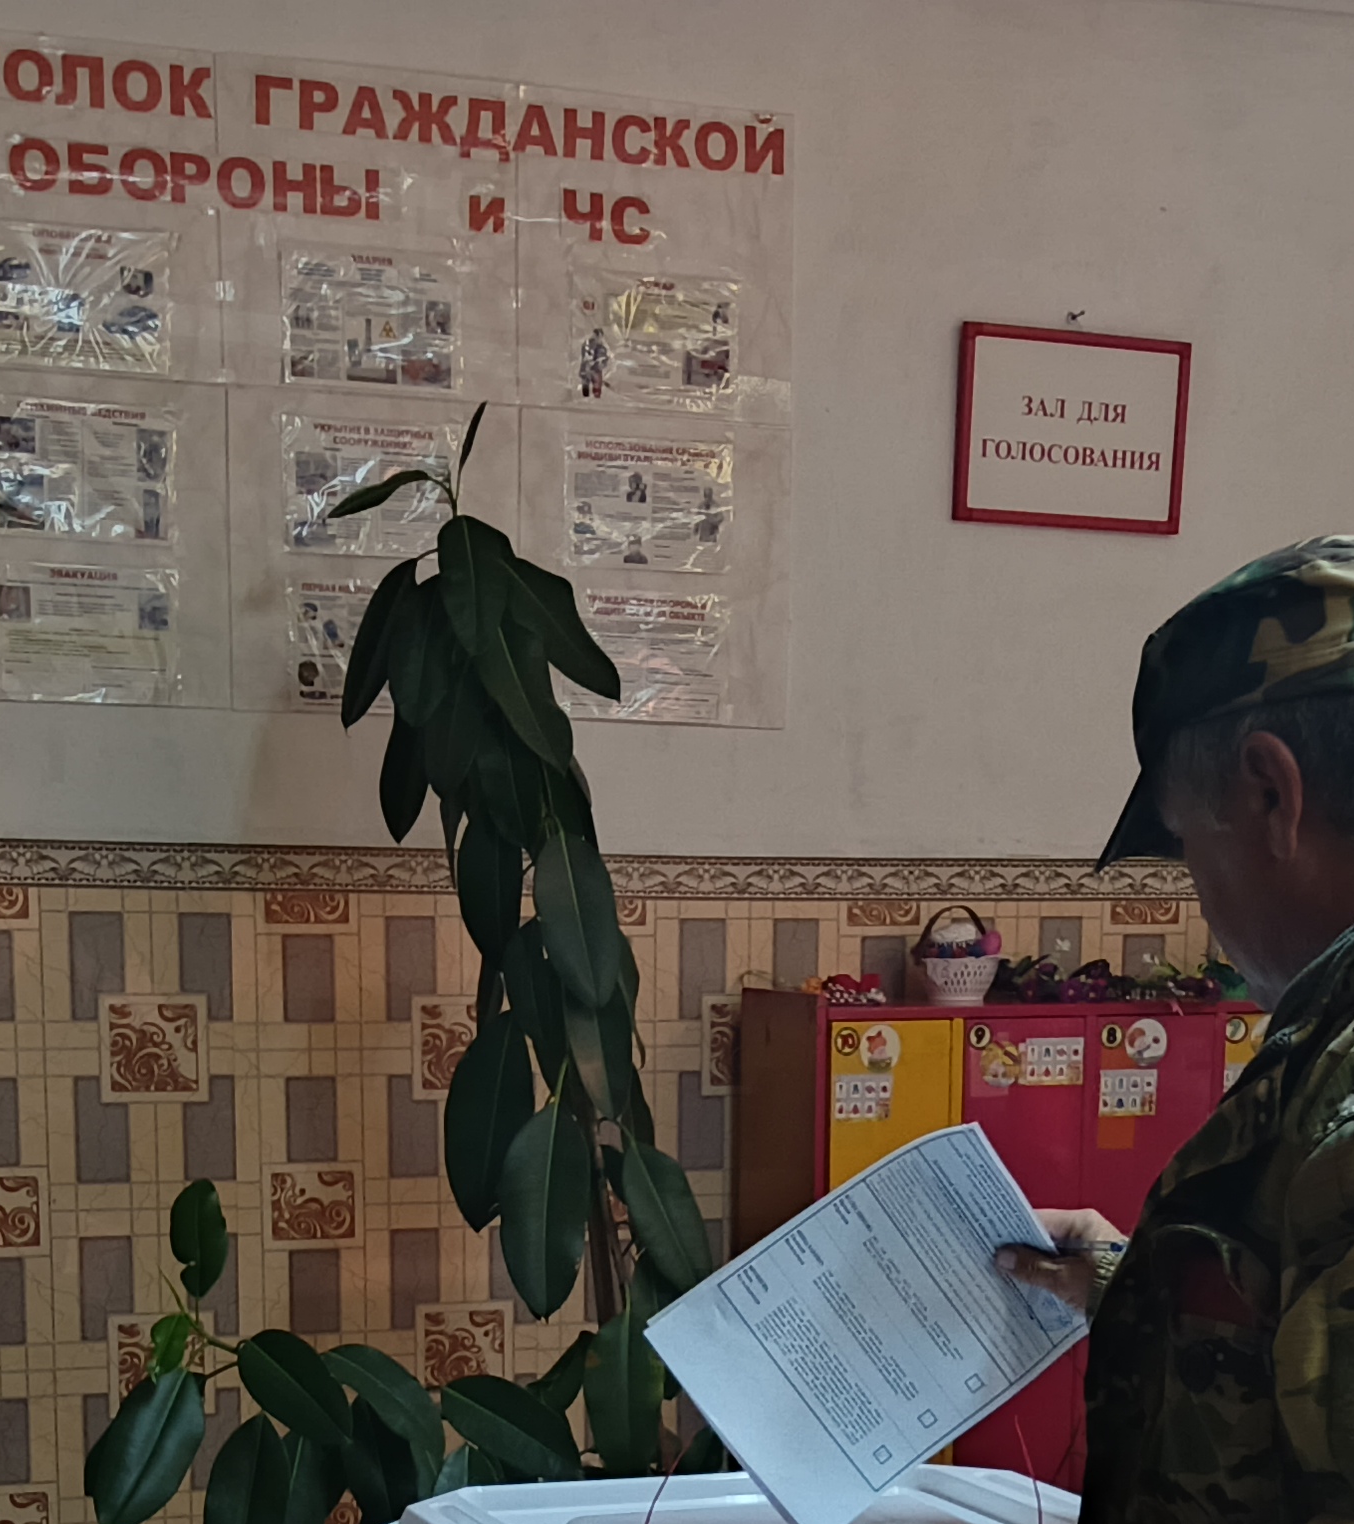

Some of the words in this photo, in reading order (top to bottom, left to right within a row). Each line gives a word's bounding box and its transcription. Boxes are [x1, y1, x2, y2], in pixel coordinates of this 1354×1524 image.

[254, 74, 785, 175] ГРАЖДАНСКОЙ
[8, 138, 380, 220] ОБОРОНЫ
[468, 195, 505, 234] и
[562, 189, 651, 245] ЧС
[1022, 396, 1066, 419] ЗАЛ
[1076, 401, 1127, 425] ДЛЯ
[981, 438, 1161, 471] ГОЛОСОВАНИЯ
[49, 568, 118, 581] ЭВАКУАЦИЯ
[974, 1026, 986, 1045] 9
[1106, 1026, 1118, 1044] 8
